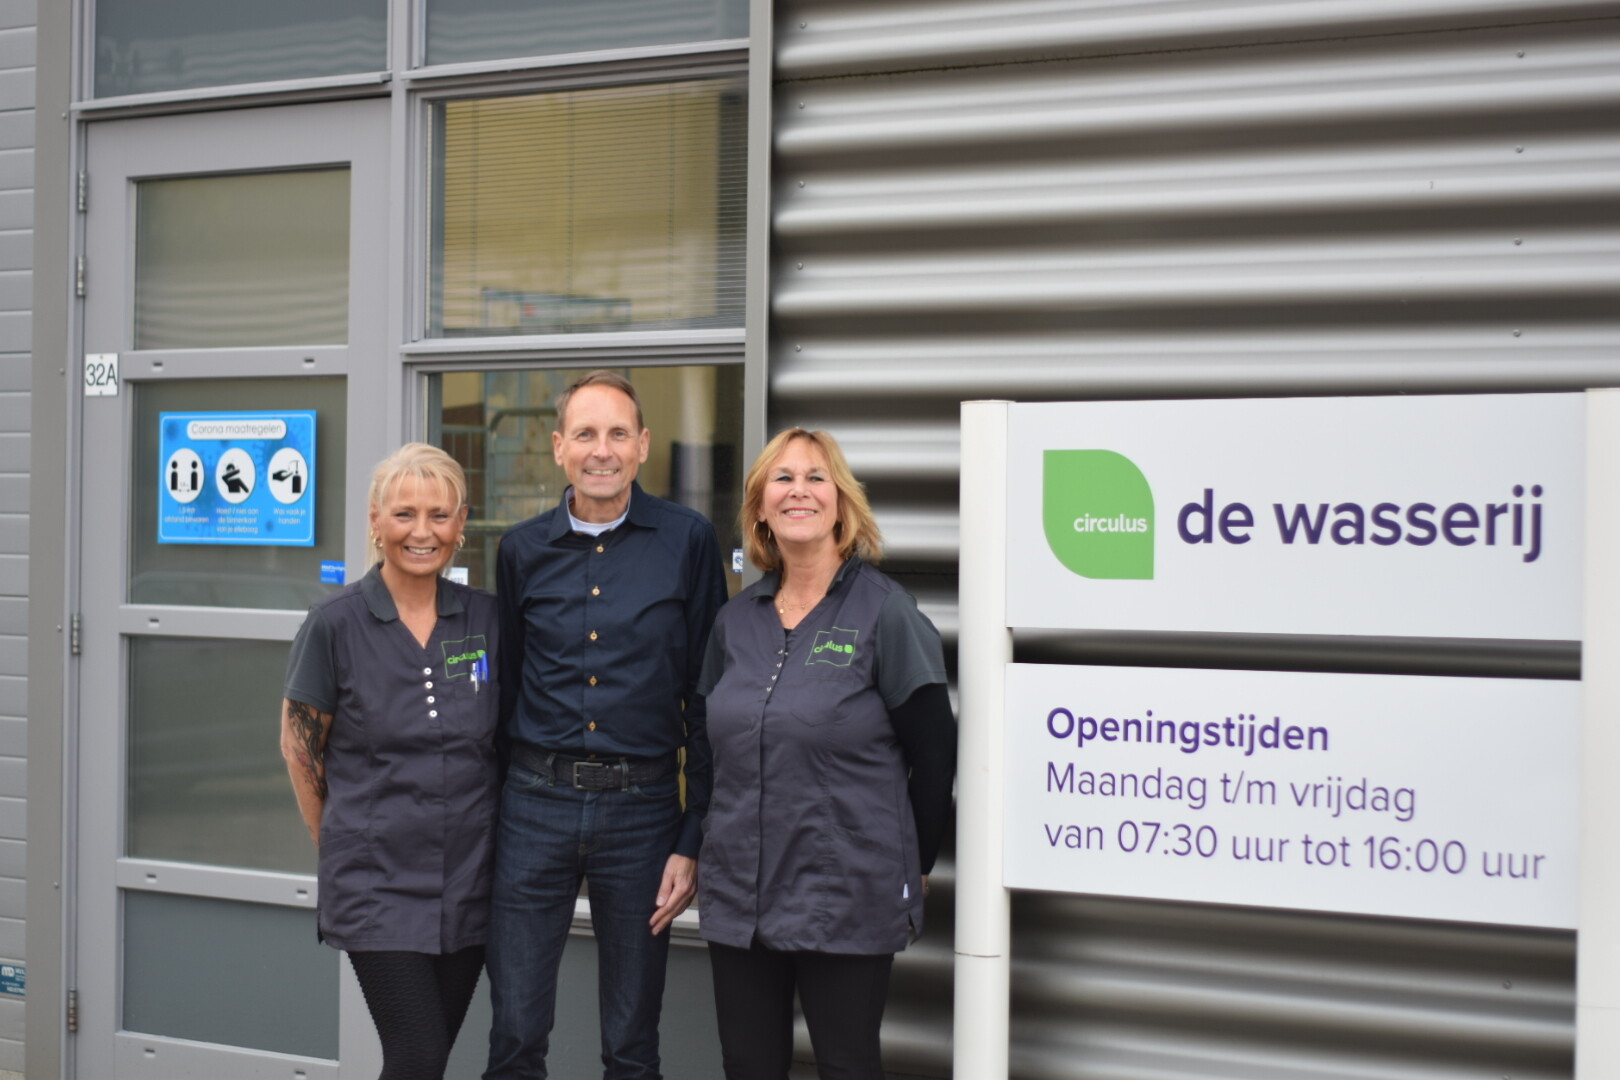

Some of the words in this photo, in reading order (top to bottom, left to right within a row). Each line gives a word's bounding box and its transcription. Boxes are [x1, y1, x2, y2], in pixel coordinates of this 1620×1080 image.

[86, 363, 117, 386] 32A
[191, 423, 224, 435] Corona
[225, 422, 283, 437] maatregelen
[1073, 512, 1149, 533] circulus
[1177, 487, 1257, 545] de
[1273, 484, 1545, 563] wasserij
[1045, 706, 1331, 757] Openingstijden
[1045, 761, 1209, 811] Maandag
[1220, 770, 1278, 806] t/m
[1288, 777, 1417, 823] vrijdag
[1043, 823, 1106, 850] van
[1116, 820, 1219, 860] 07:30
[1231, 836, 1291, 864] uur
[1302, 834, 1353, 868] tot
[1364, 835, 1468, 876] 16:00
[1482, 851, 1547, 880] uur
